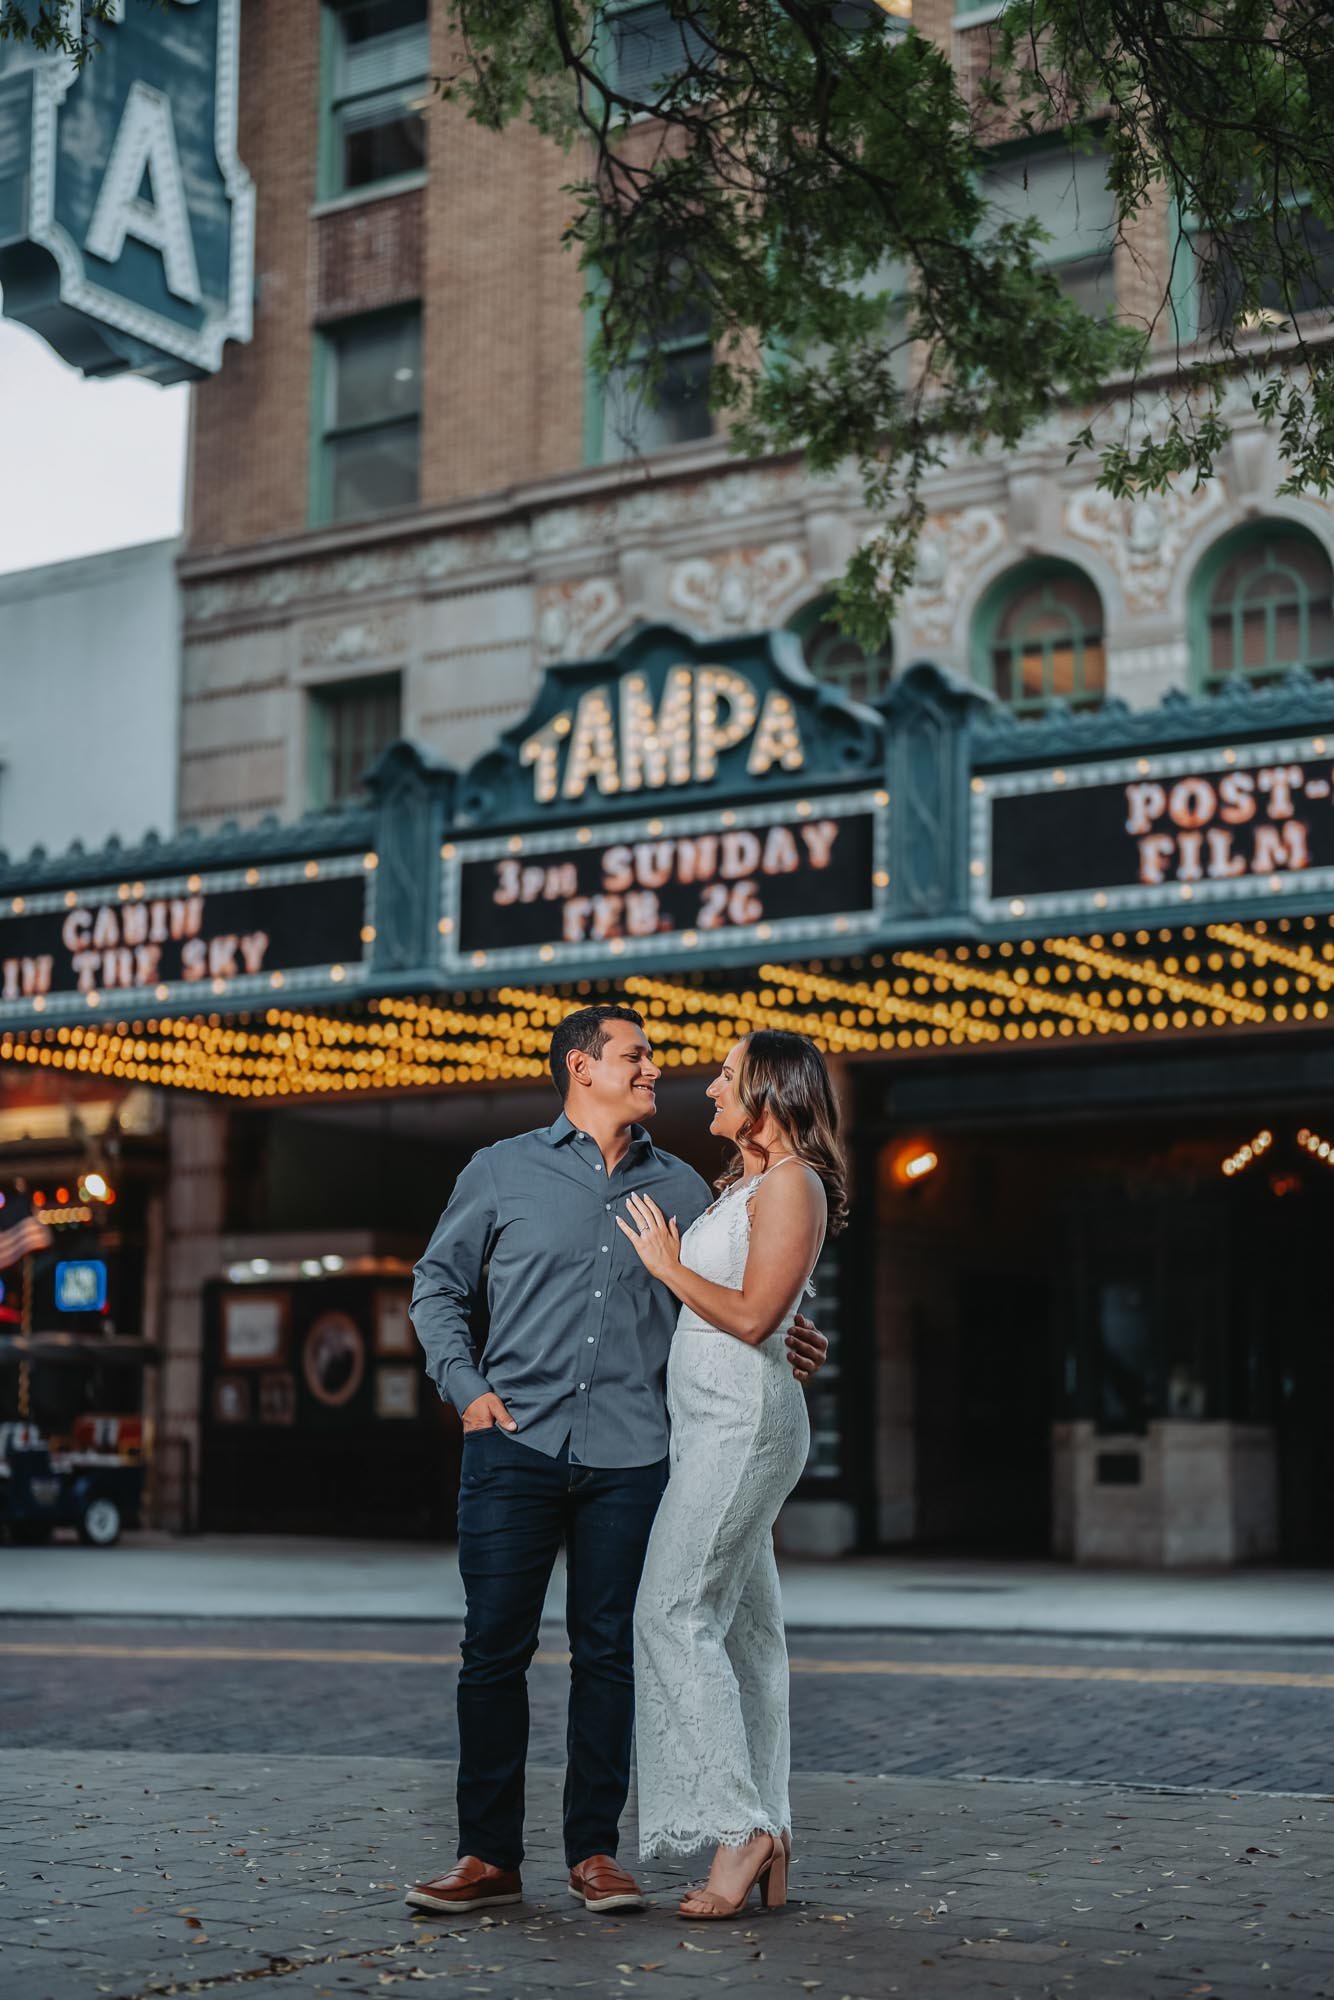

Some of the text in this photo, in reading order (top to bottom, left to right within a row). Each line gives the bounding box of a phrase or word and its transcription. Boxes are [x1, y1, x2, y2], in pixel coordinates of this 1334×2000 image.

[519, 664, 805, 803] TAMPA
[1124, 764, 1334, 836] POST-
[602, 820, 839, 893] SUNDAY
[1136, 820, 1311, 885] FILM
[696, 880, 764, 930] 26
[71, 944, 163, 995] THE
[181, 930, 270, 983] SKY
